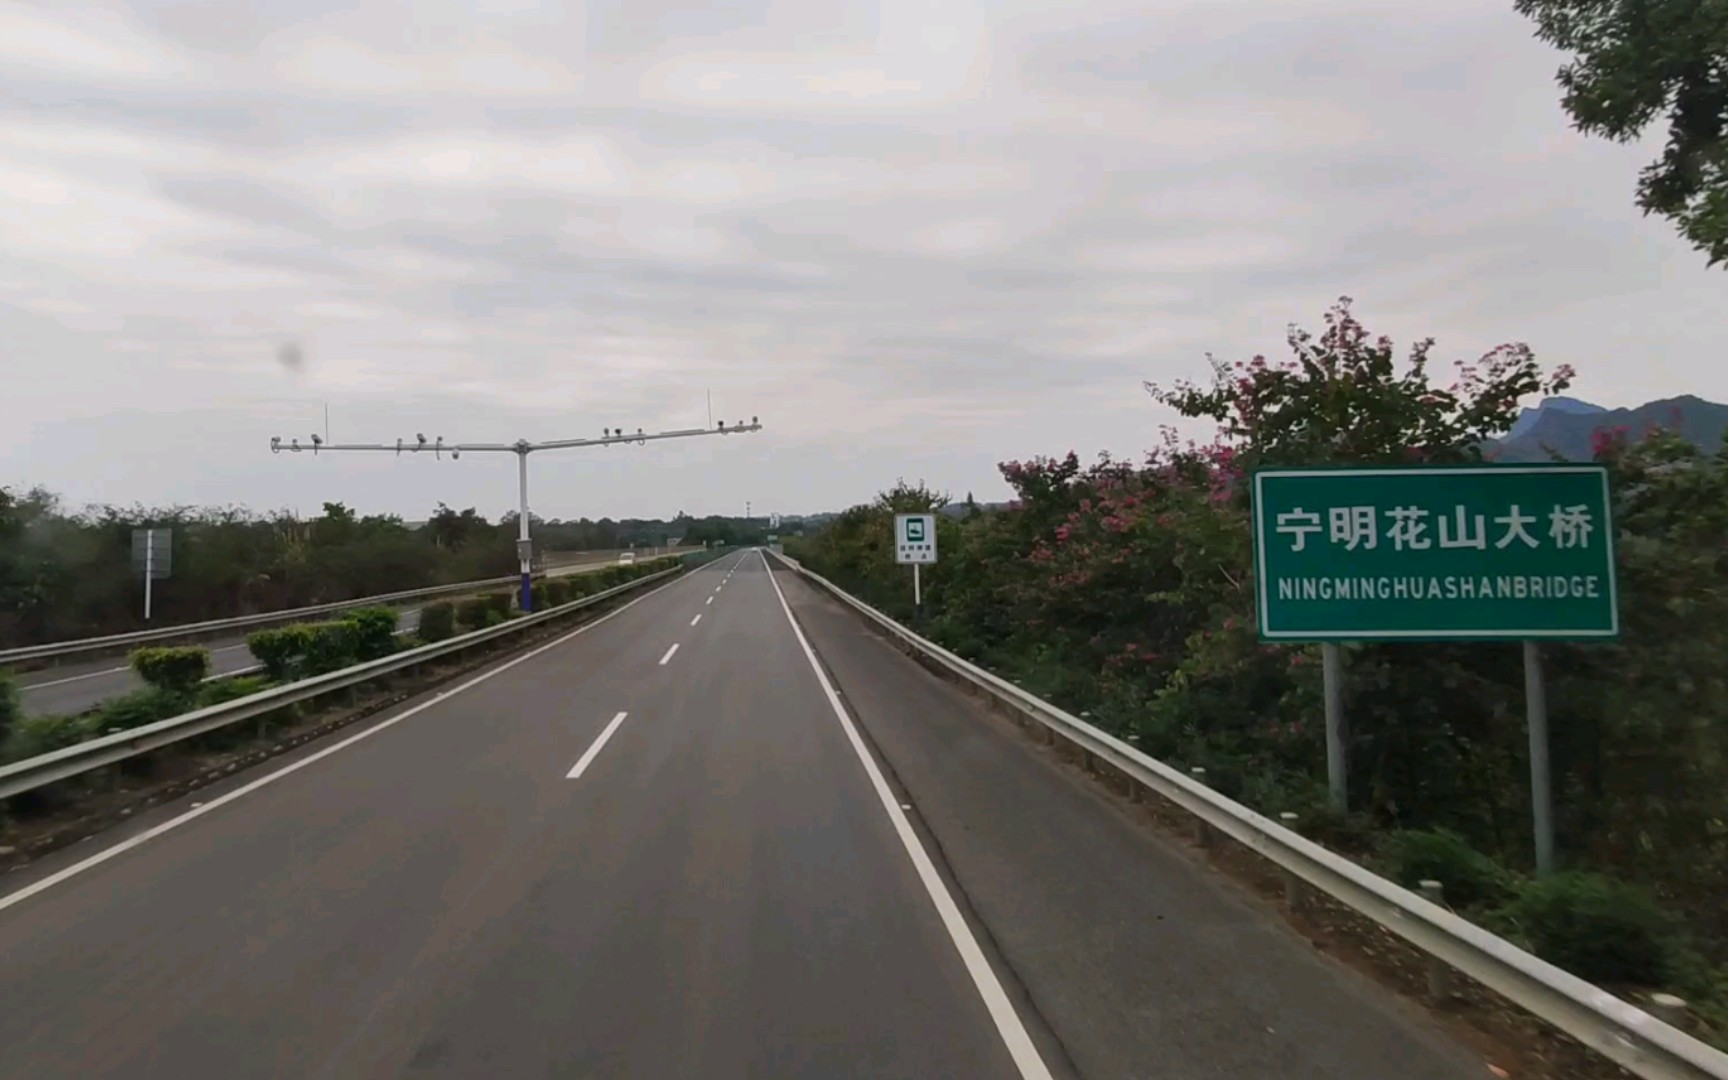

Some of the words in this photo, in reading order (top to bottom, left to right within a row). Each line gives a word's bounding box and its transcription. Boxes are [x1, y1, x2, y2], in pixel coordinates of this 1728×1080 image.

[1276, 504, 1593, 552] 宁明花山大桥
[1278, 576, 1600, 600] NINGMINGHUASHANBRIDGE
